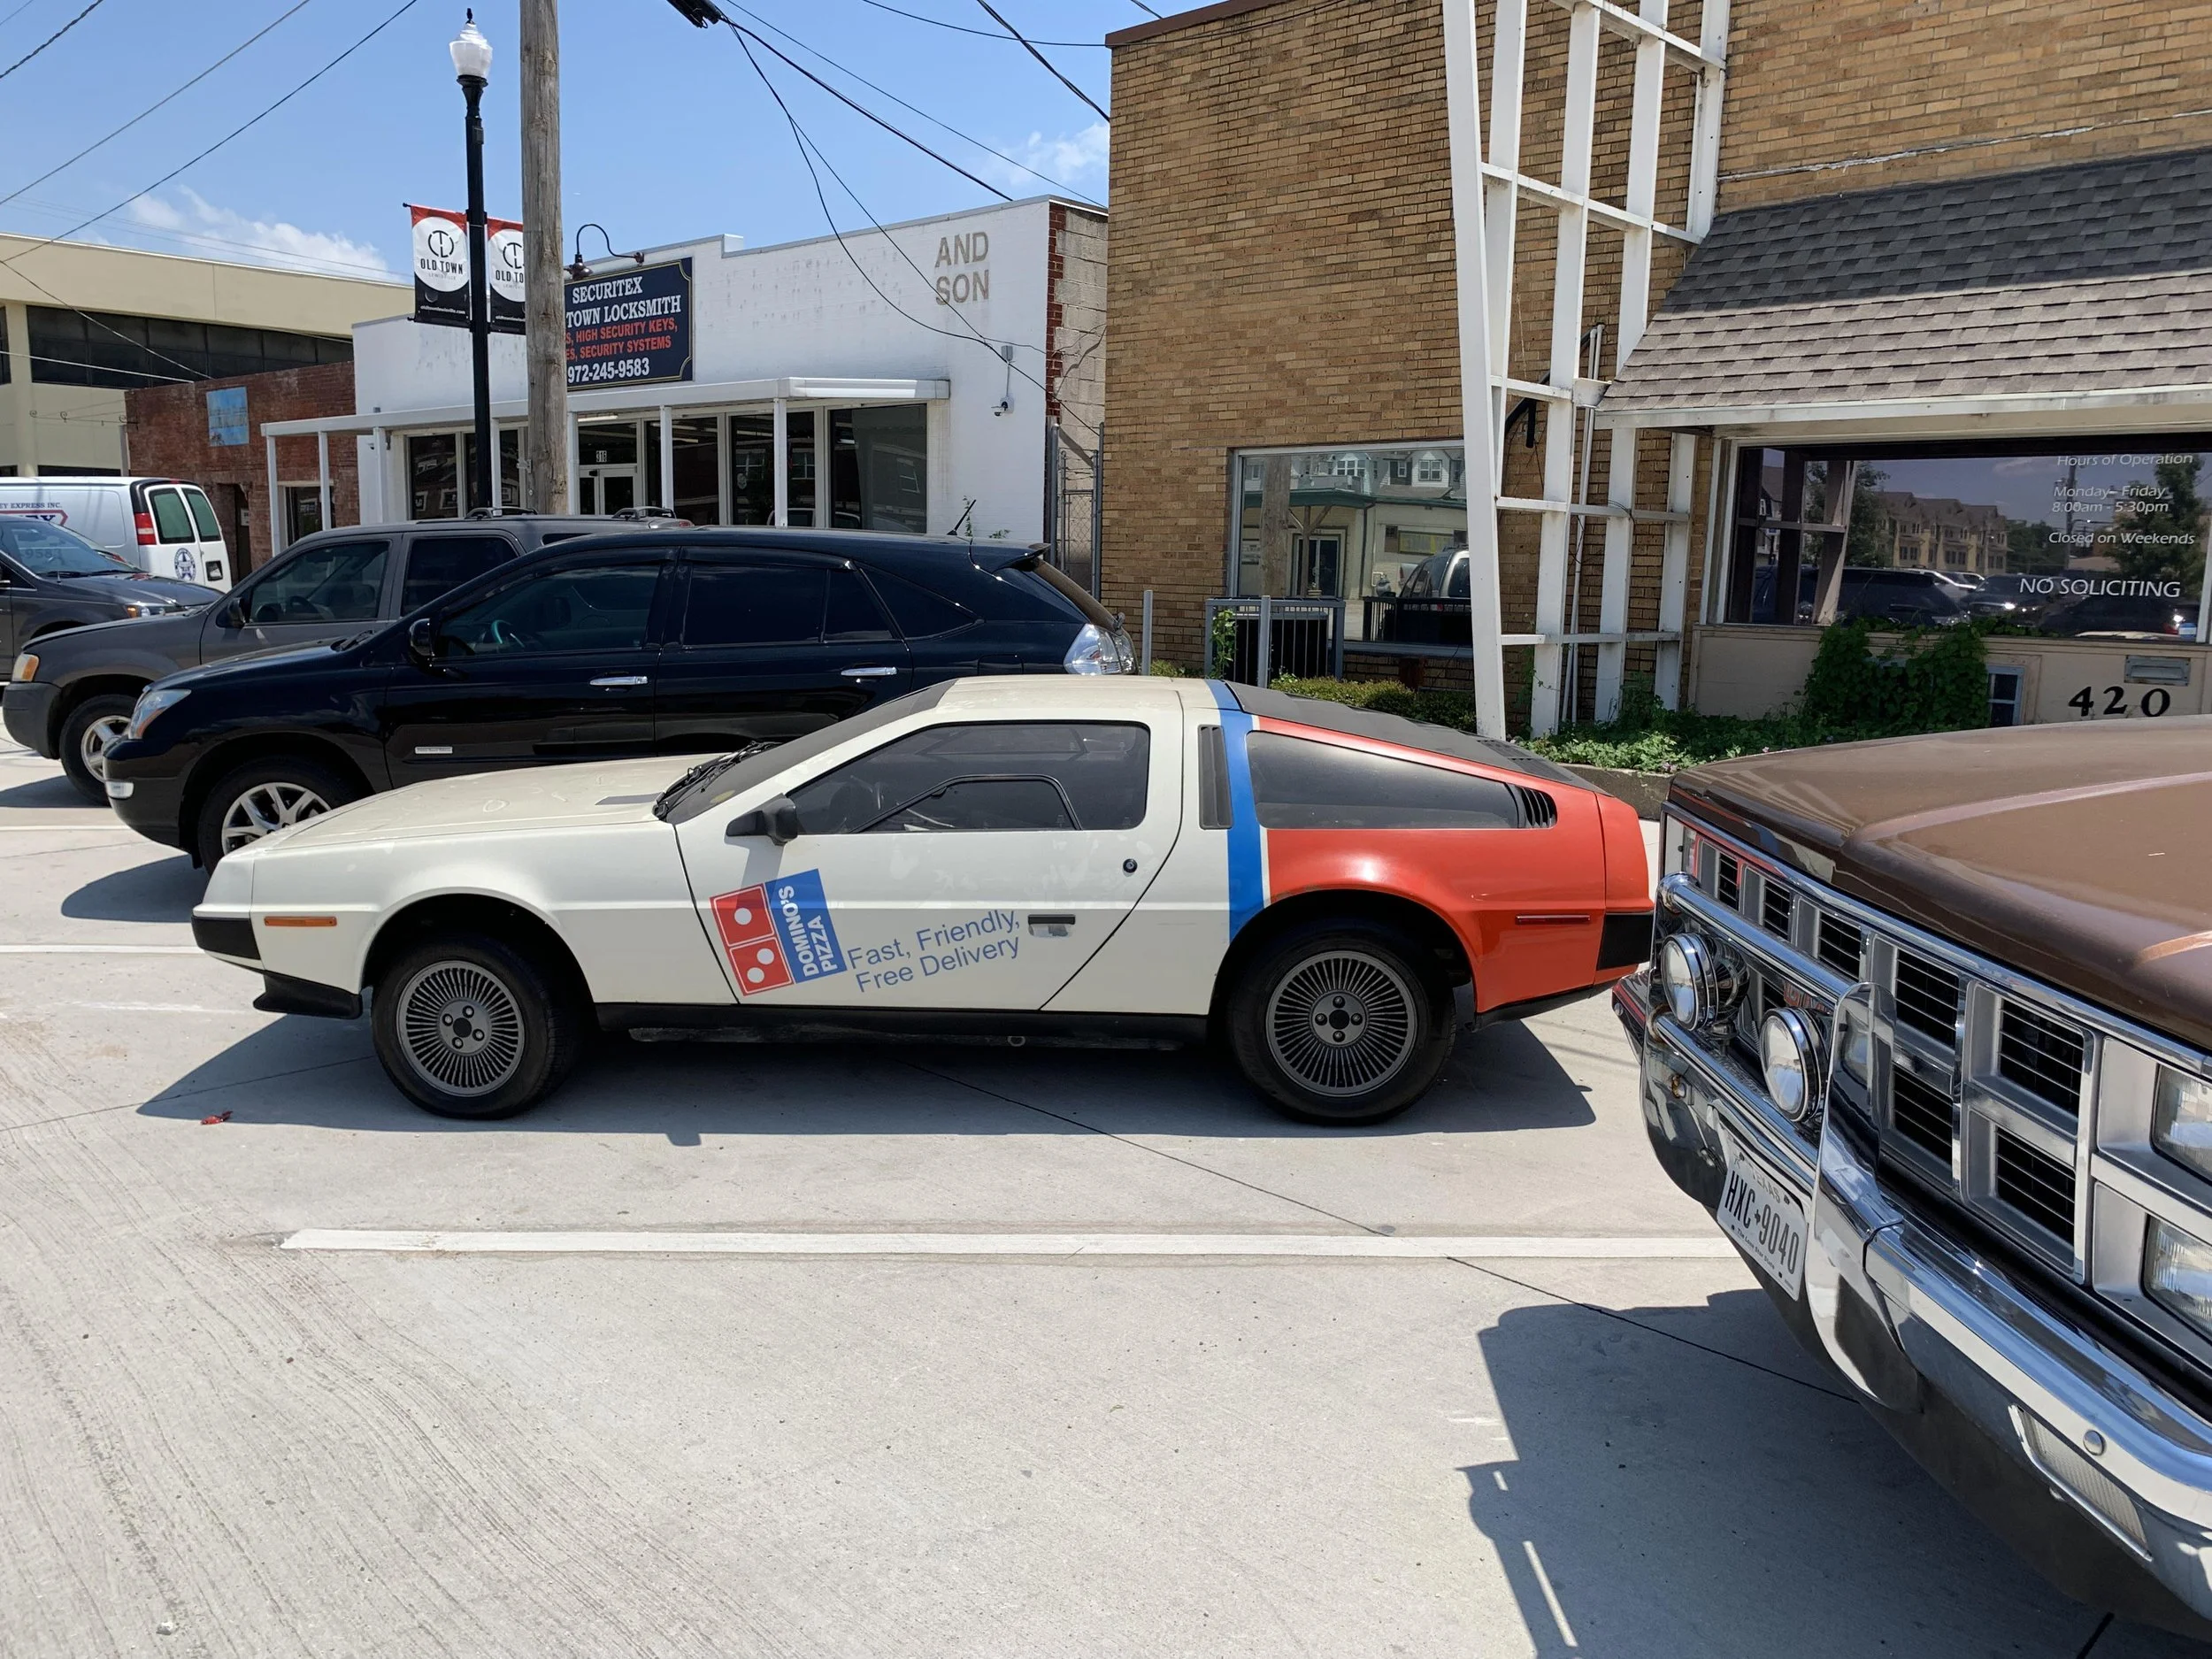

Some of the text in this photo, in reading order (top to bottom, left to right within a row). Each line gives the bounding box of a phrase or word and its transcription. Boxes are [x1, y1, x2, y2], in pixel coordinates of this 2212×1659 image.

[934, 232, 989, 267] AND
[420, 258, 463, 274] OLD TOWN
[495, 270, 524, 283] OLD TO
[572, 276, 643, 303] SECURITEX
[935, 269, 989, 305] SON
[566, 295, 681, 328] TOWN LOCKSMITH
[576, 328, 597, 342] HIGH
[600, 321, 646, 340] SECURITY
[649, 317, 678, 333] KEYS,
[565, 335, 672, 362] ES, SECURITY SYSTEMS
[567, 357, 650, 383] 972-245-9583
[2057, 453, 2193, 467] Hours of Operation
[2122, 485, 2166, 500] Friday
[2052, 502, 2102, 512] 8:00am
[2115, 501, 2169, 514] 5:30pm
[2048, 532, 2195, 545] Closed on Weekends
[2019, 578, 2181, 598] NO SOLICITING
[2068, 686, 2170, 718] 420
[779, 886, 819, 977] DOMINO'S
[807, 915, 838, 972] PIZZA
[848, 910, 1020, 970] Fast, Friendly,
[856, 936, 1019, 993] Free Delivery
[1749, 1164, 1781, 1204] TEXAS
